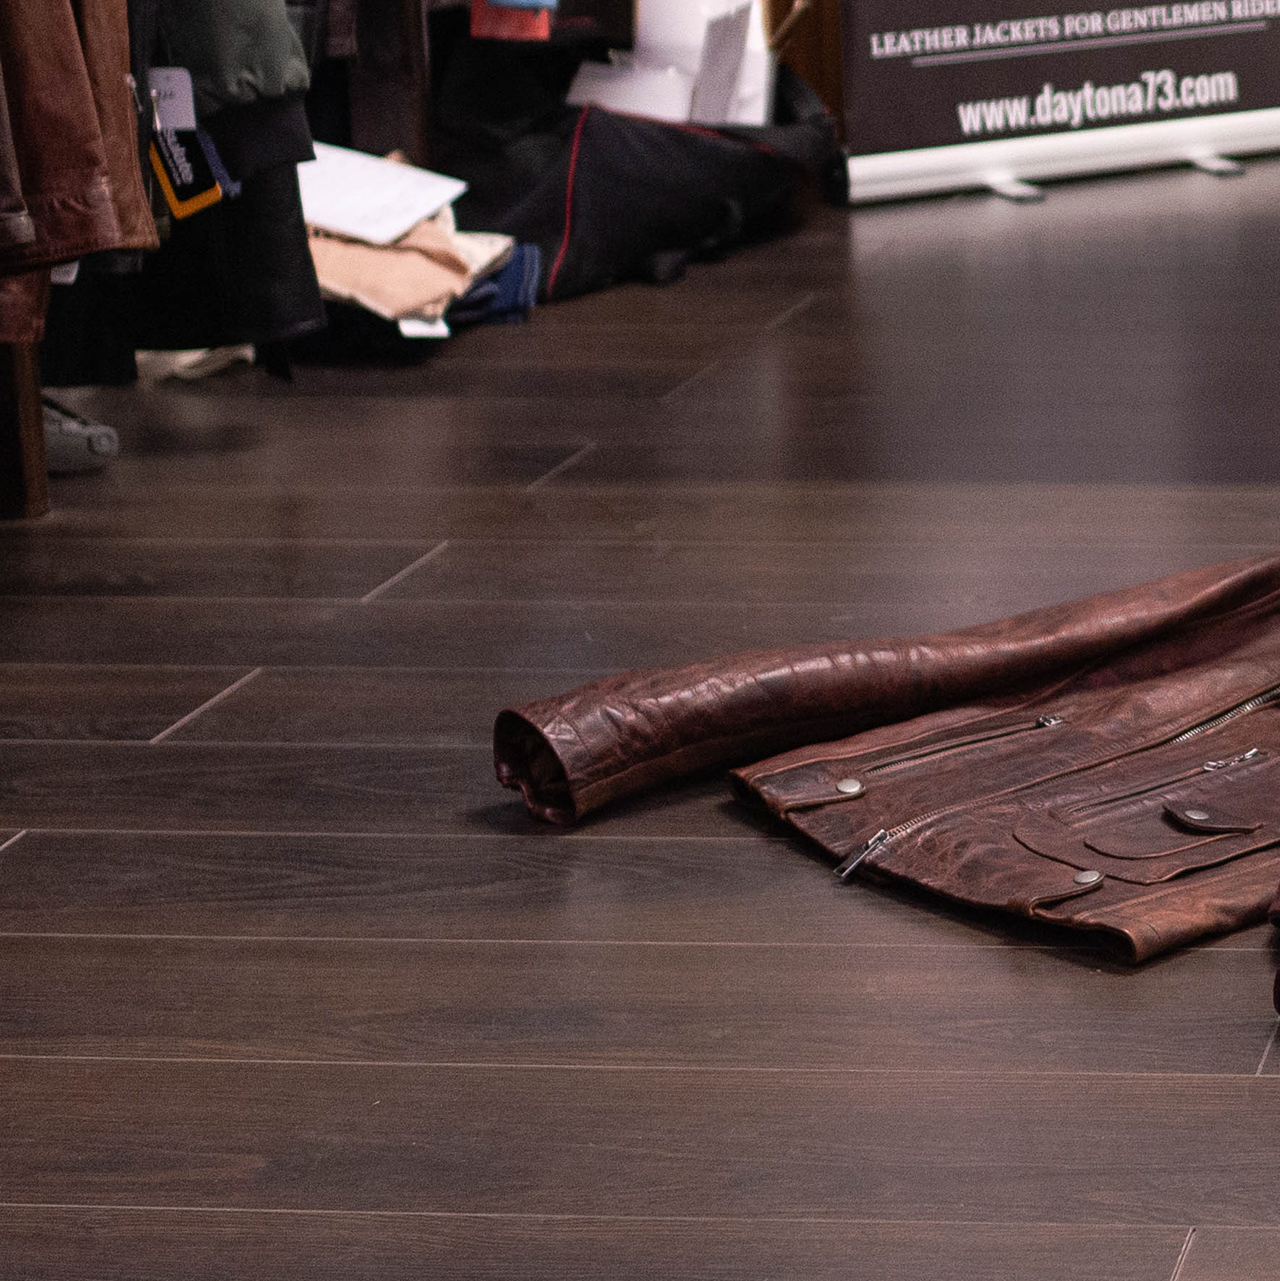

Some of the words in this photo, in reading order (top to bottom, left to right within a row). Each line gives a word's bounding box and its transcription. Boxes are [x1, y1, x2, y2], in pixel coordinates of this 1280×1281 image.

[870, 28, 969, 60] LEATHER
[971, 17, 1060, 48] JACKETS
[1063, 11, 1105, 37] FOR
[957, 68, 1239, 137] www.daytona73.com
